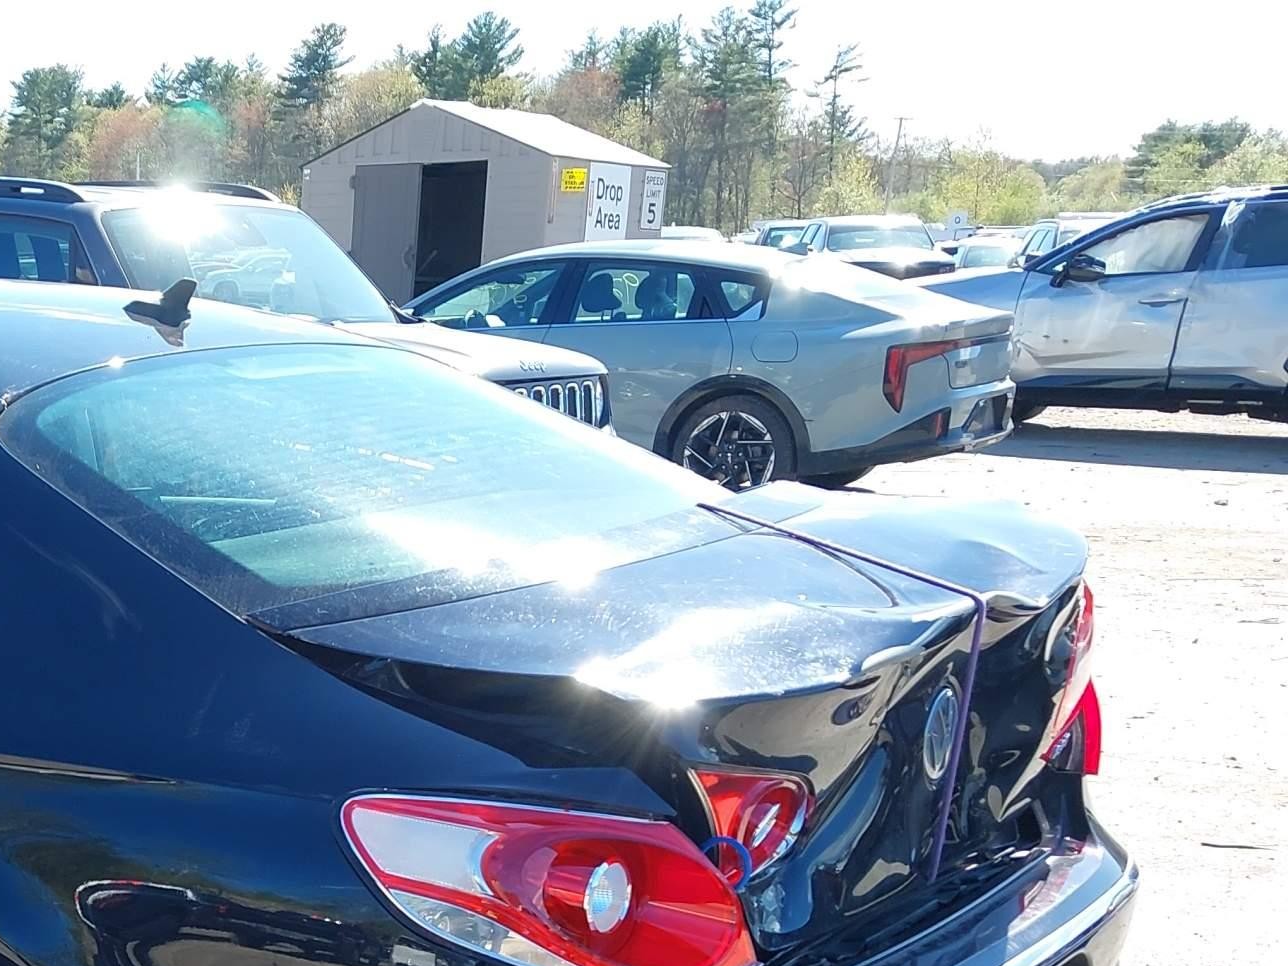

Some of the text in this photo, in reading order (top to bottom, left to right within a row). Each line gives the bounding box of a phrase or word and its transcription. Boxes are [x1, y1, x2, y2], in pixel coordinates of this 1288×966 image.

[646, 175, 665, 186] SPEED
[596, 177, 623, 206] Drop
[645, 188, 662, 199] LIMIT
[594, 206, 621, 230] Area
[647, 203, 657, 224] 5
